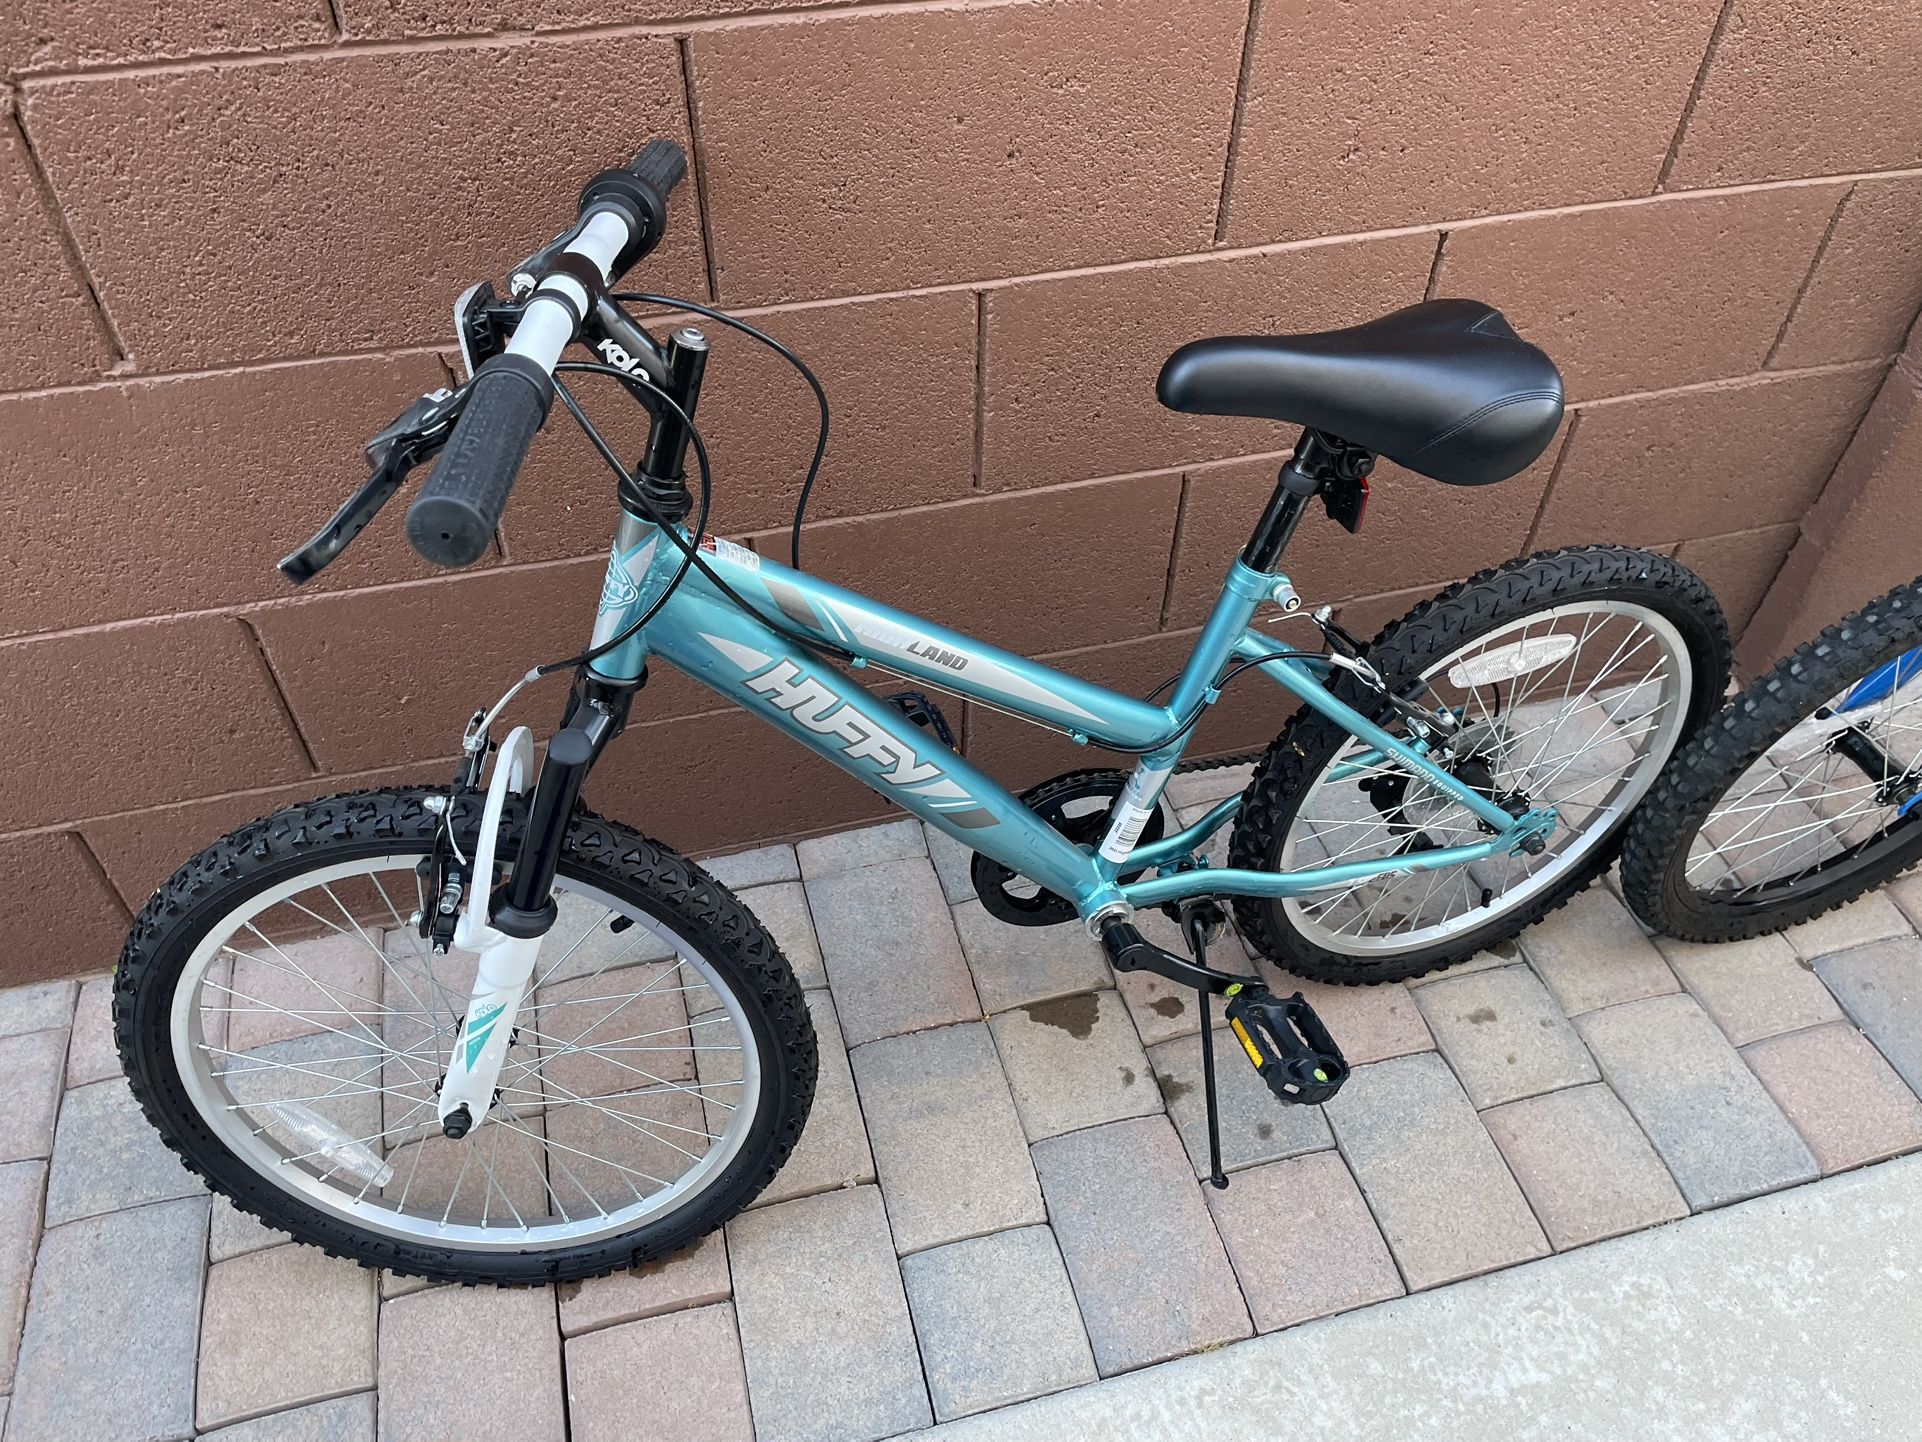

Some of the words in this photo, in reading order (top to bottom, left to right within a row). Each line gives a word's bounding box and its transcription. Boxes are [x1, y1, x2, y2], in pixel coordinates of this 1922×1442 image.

[740, 656, 945, 786] HUFFY
[1387, 748, 1435, 782] SHIMANO
[1432, 780, 1464, 801] EQUIPPED
